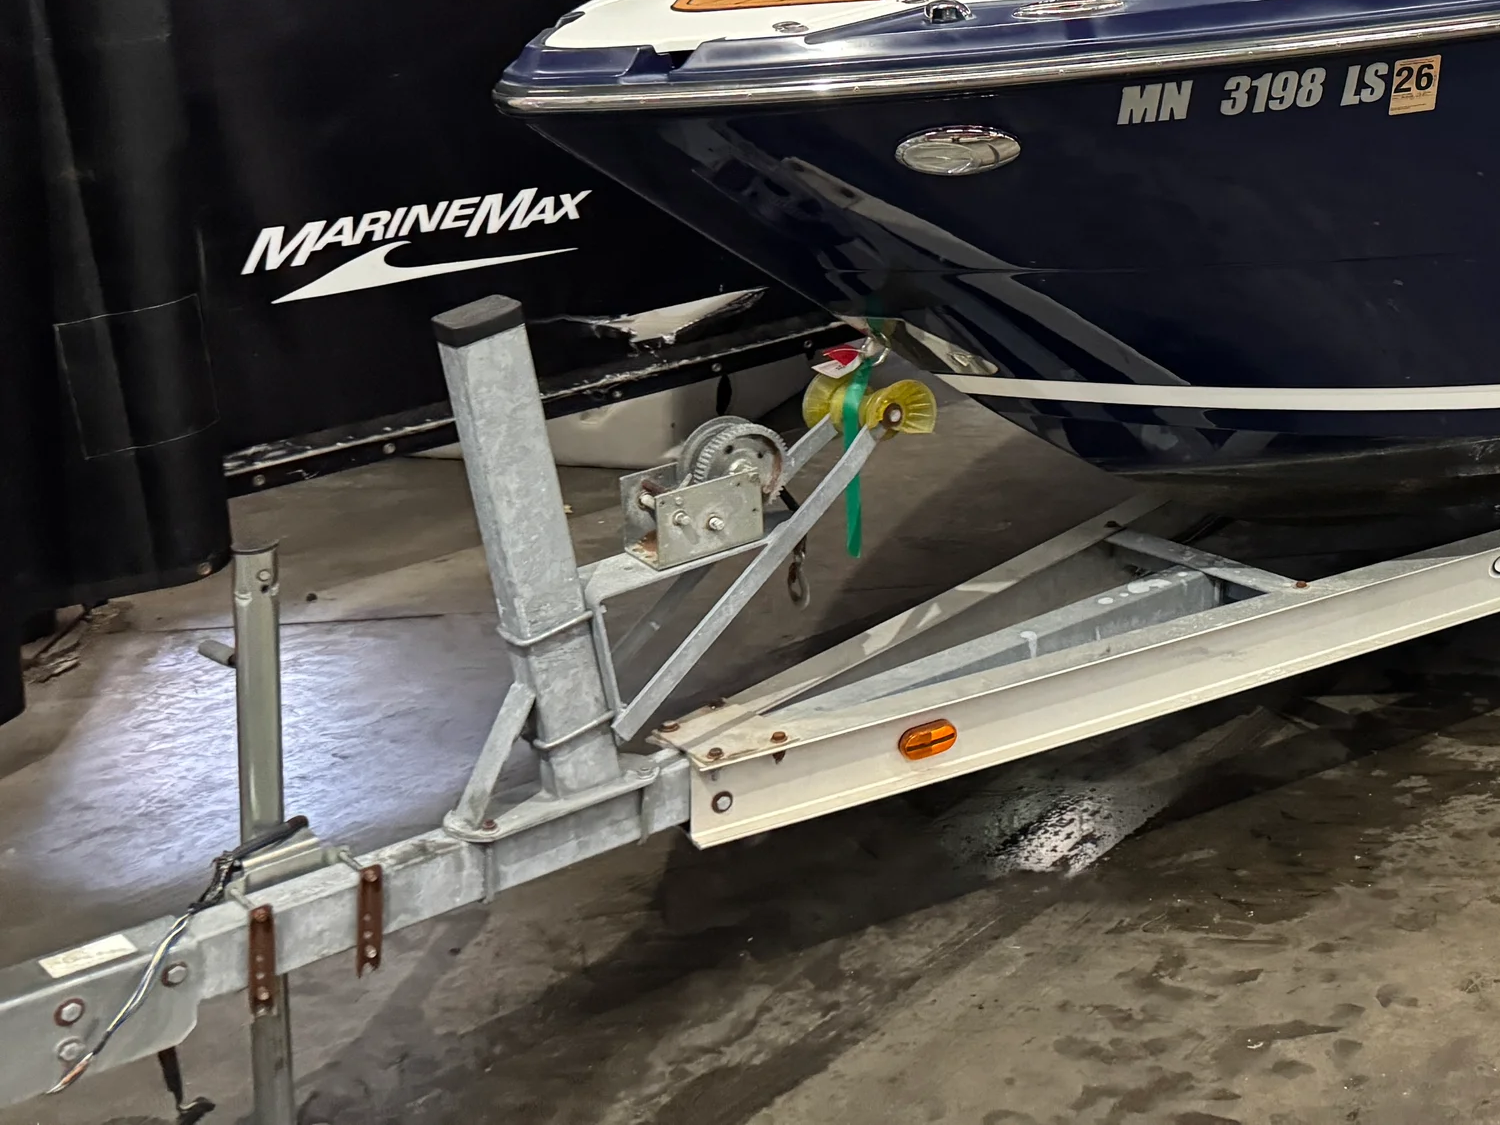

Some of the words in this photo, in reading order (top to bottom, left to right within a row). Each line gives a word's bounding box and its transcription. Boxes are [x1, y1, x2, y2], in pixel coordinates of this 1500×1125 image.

[1117, 80, 1193, 125] MN
[1220, 67, 1326, 115] 3198
[1340, 62, 1389, 106] LS
[1393, 63, 1434, 93] 26
[241, 188, 592, 275] MARINEMAX
